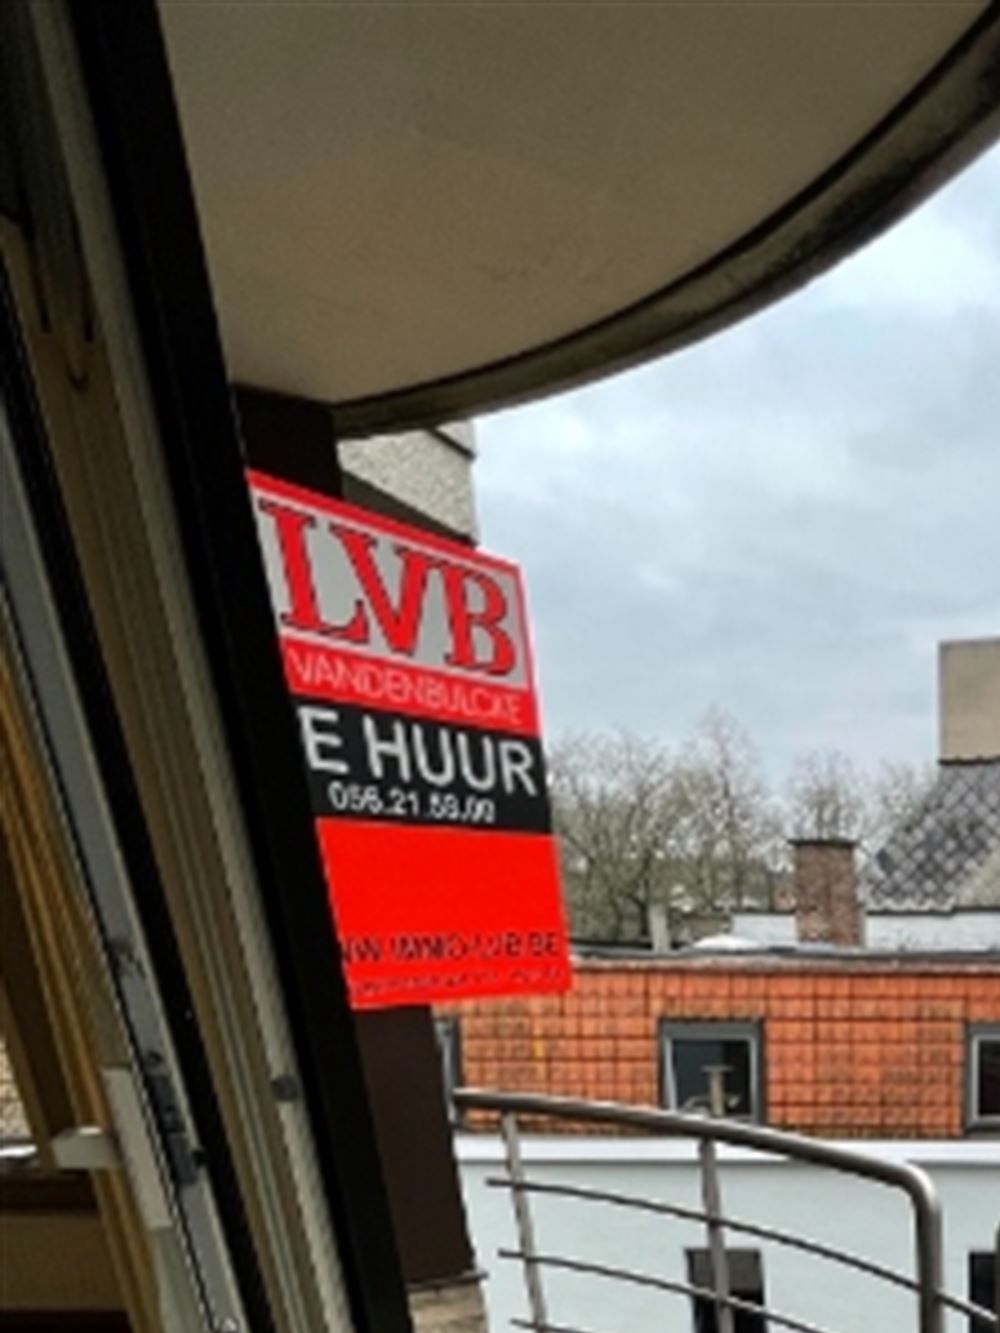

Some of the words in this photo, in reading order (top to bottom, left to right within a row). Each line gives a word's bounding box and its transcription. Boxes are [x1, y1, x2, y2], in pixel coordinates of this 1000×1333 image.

[258, 497, 517, 677] LVB
[286, 648, 522, 724] VANDENBULCKE
[362, 714, 539, 797] HUUR
